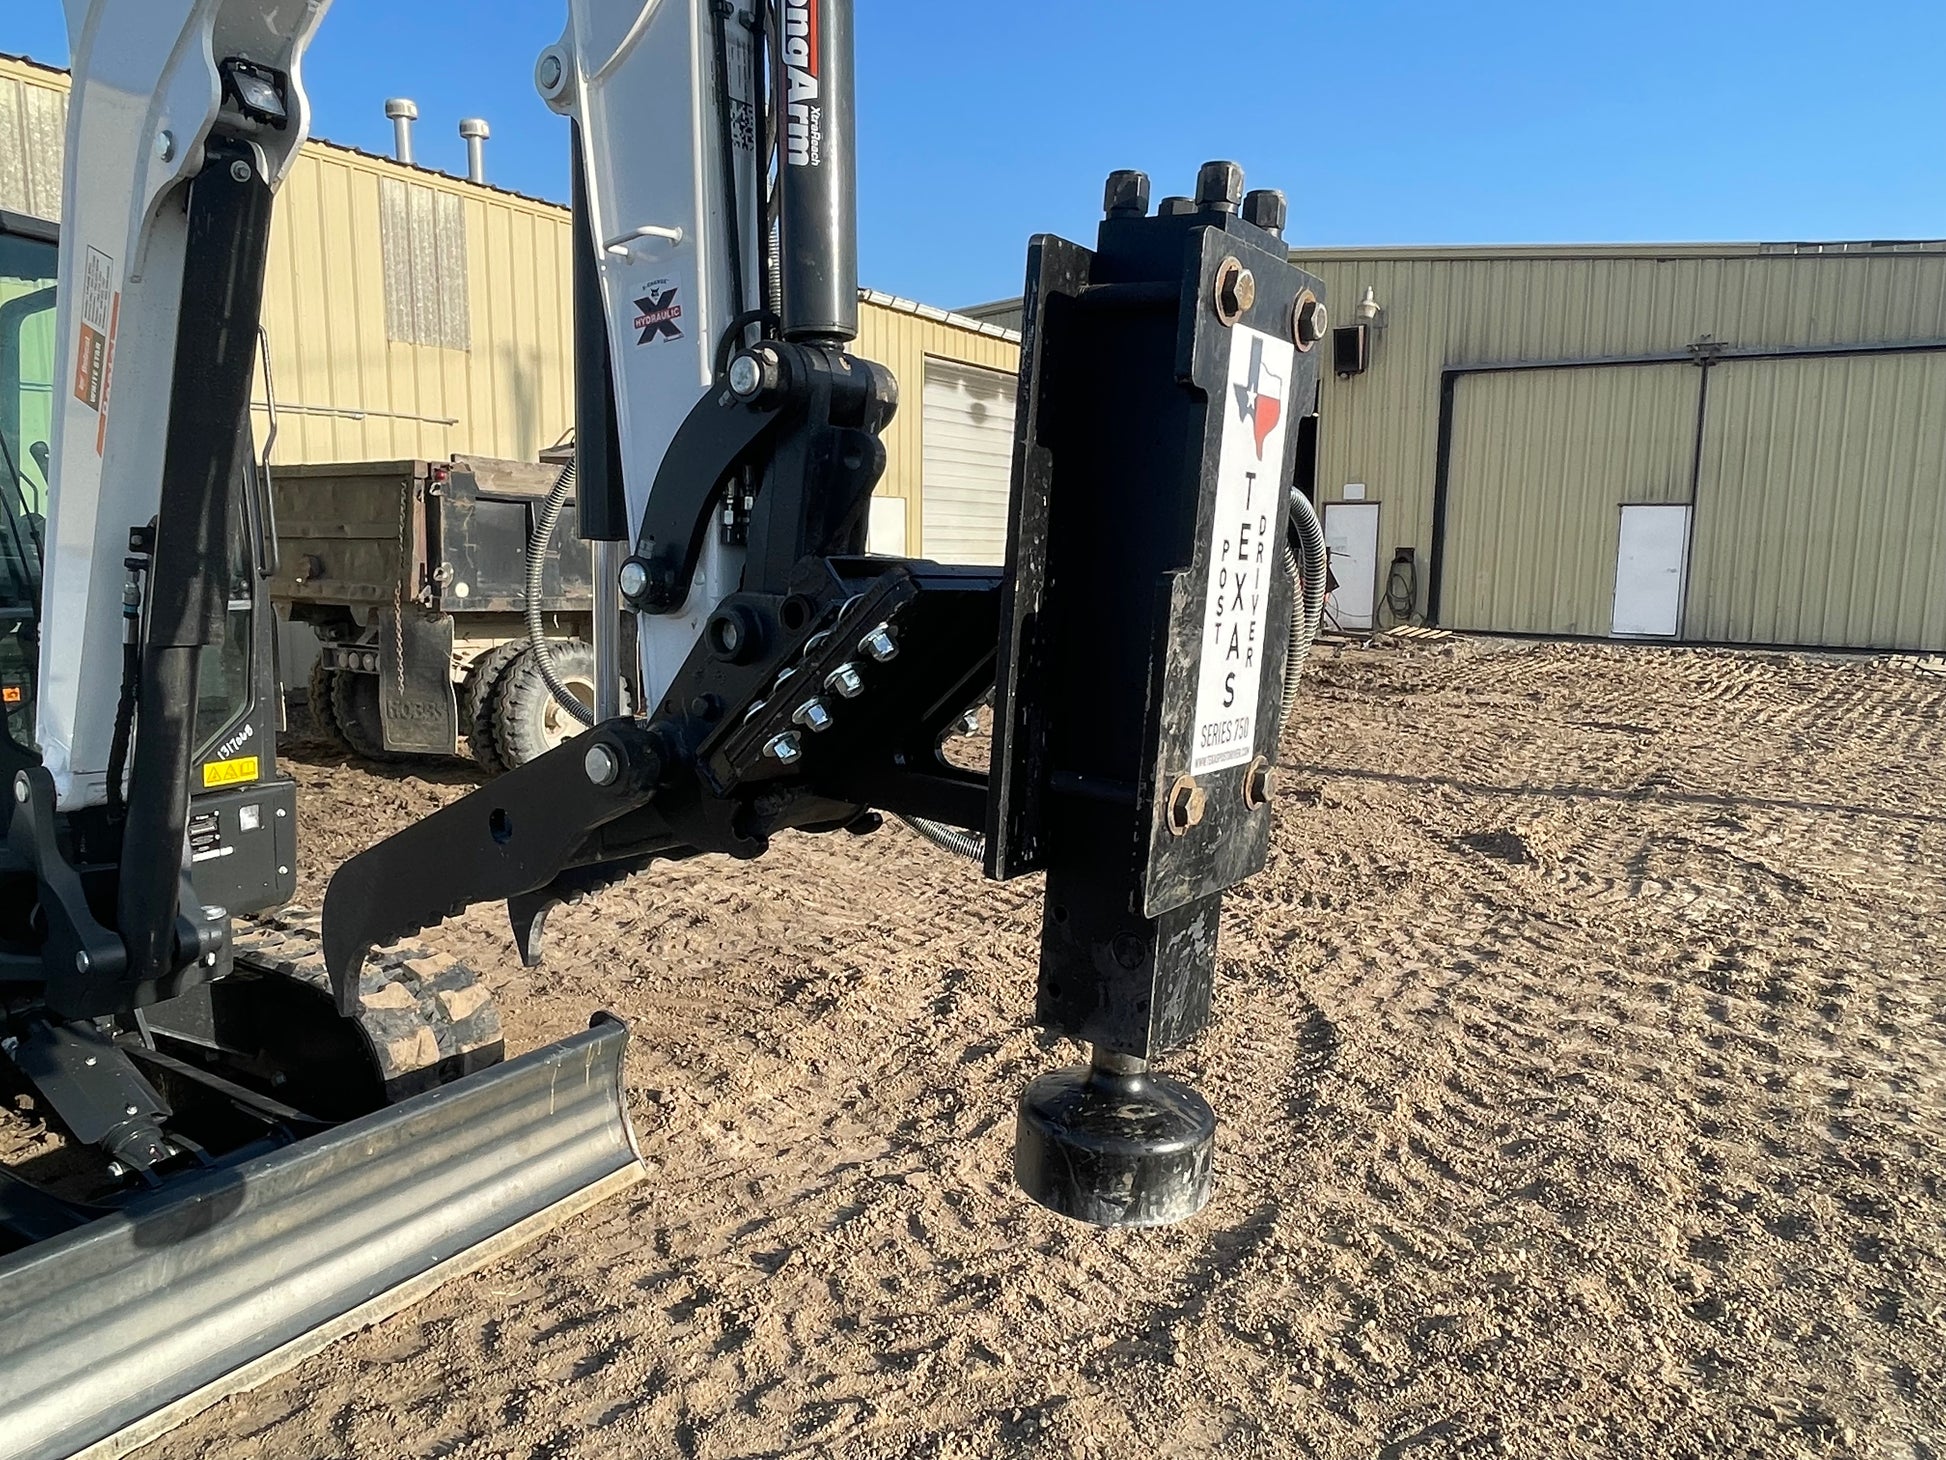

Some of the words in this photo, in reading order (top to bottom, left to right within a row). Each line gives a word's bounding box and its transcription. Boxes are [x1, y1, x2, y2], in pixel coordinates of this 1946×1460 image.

[810, 105, 822, 167] XtraReach
[635, 307, 681, 328] HYDRAULIC
[93, 342, 102, 369] STAR
[89, 369, 99, 403] WHITE
[1213, 538, 1230, 646] POST
[1222, 471, 1257, 709] TEXAS
[1244, 514, 1268, 669] DRIVER
[1200, 720, 1233, 748] SERIES
[1233, 717, 1250, 742] 750
